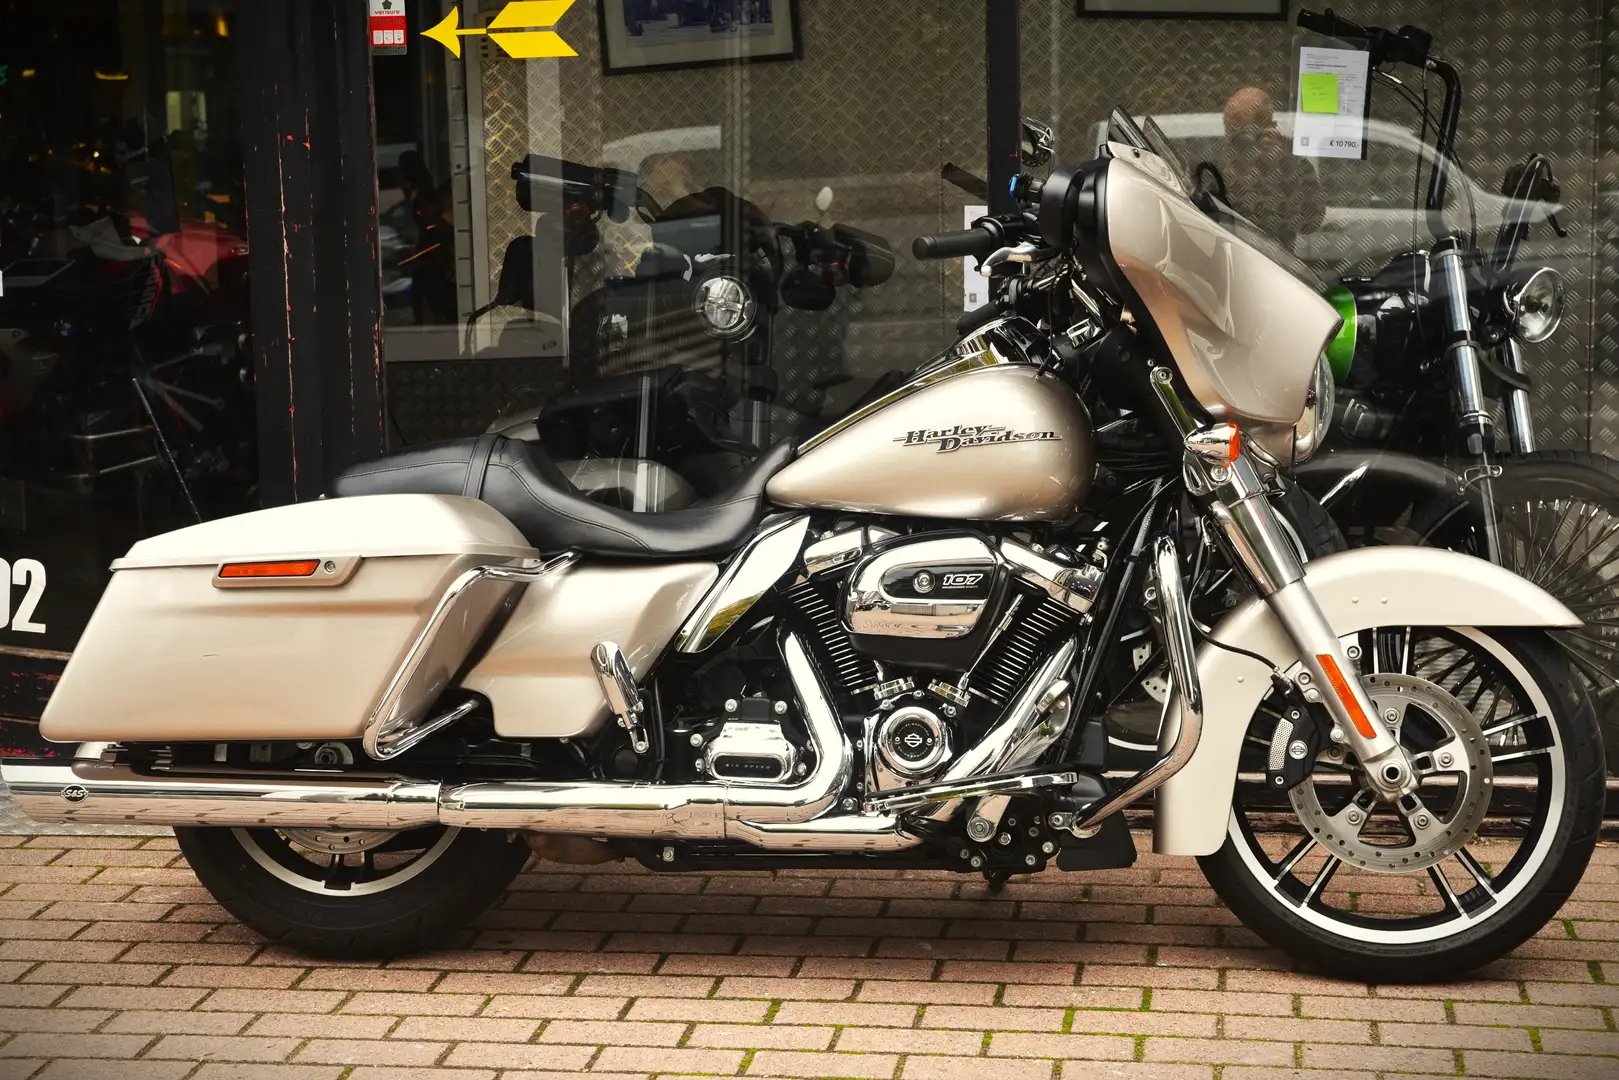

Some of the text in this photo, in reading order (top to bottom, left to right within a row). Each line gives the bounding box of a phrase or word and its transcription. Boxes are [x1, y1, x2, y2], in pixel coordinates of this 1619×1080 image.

[903, 424, 993, 446] Harley
[936, 430, 1058, 454] Davidson
[942, 573, 984, 586] 107
[64, 789, 84, 798] S&S
